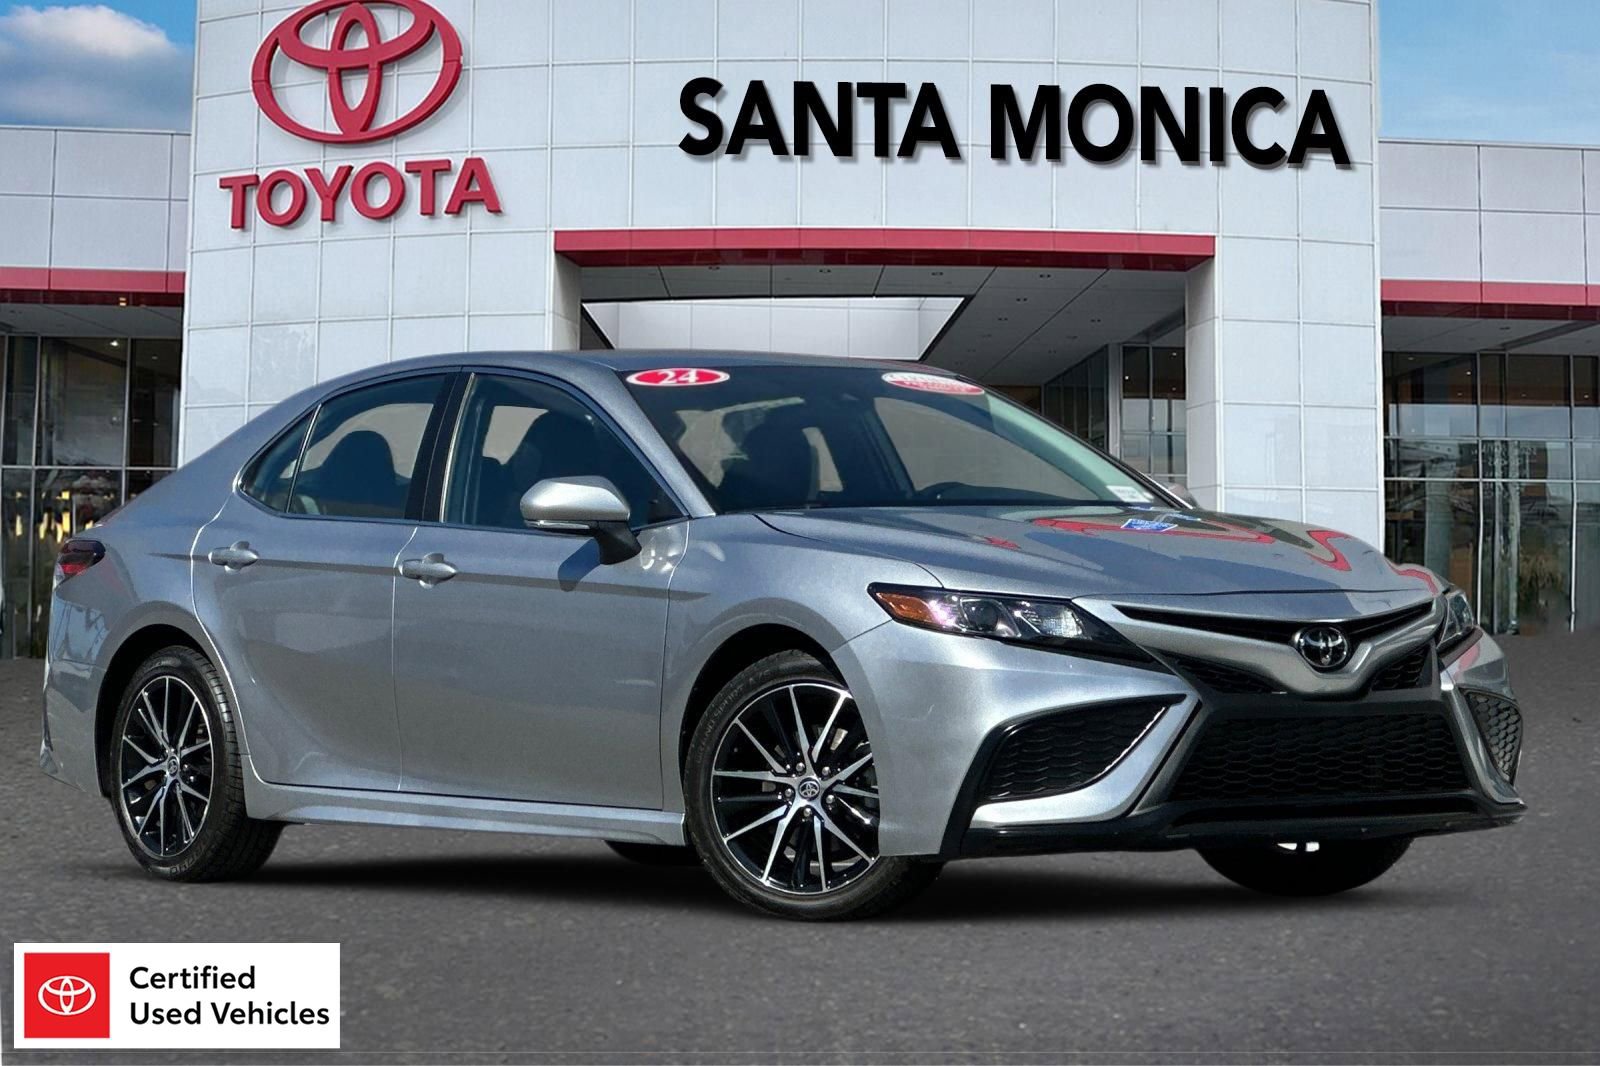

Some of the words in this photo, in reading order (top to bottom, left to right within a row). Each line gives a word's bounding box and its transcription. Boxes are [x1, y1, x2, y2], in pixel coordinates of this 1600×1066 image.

[678, 77, 961, 159] SANTA
[989, 84, 1352, 168] MONICA
[220, 157, 502, 229] TOYOTA
[657, 369, 699, 384] 24
